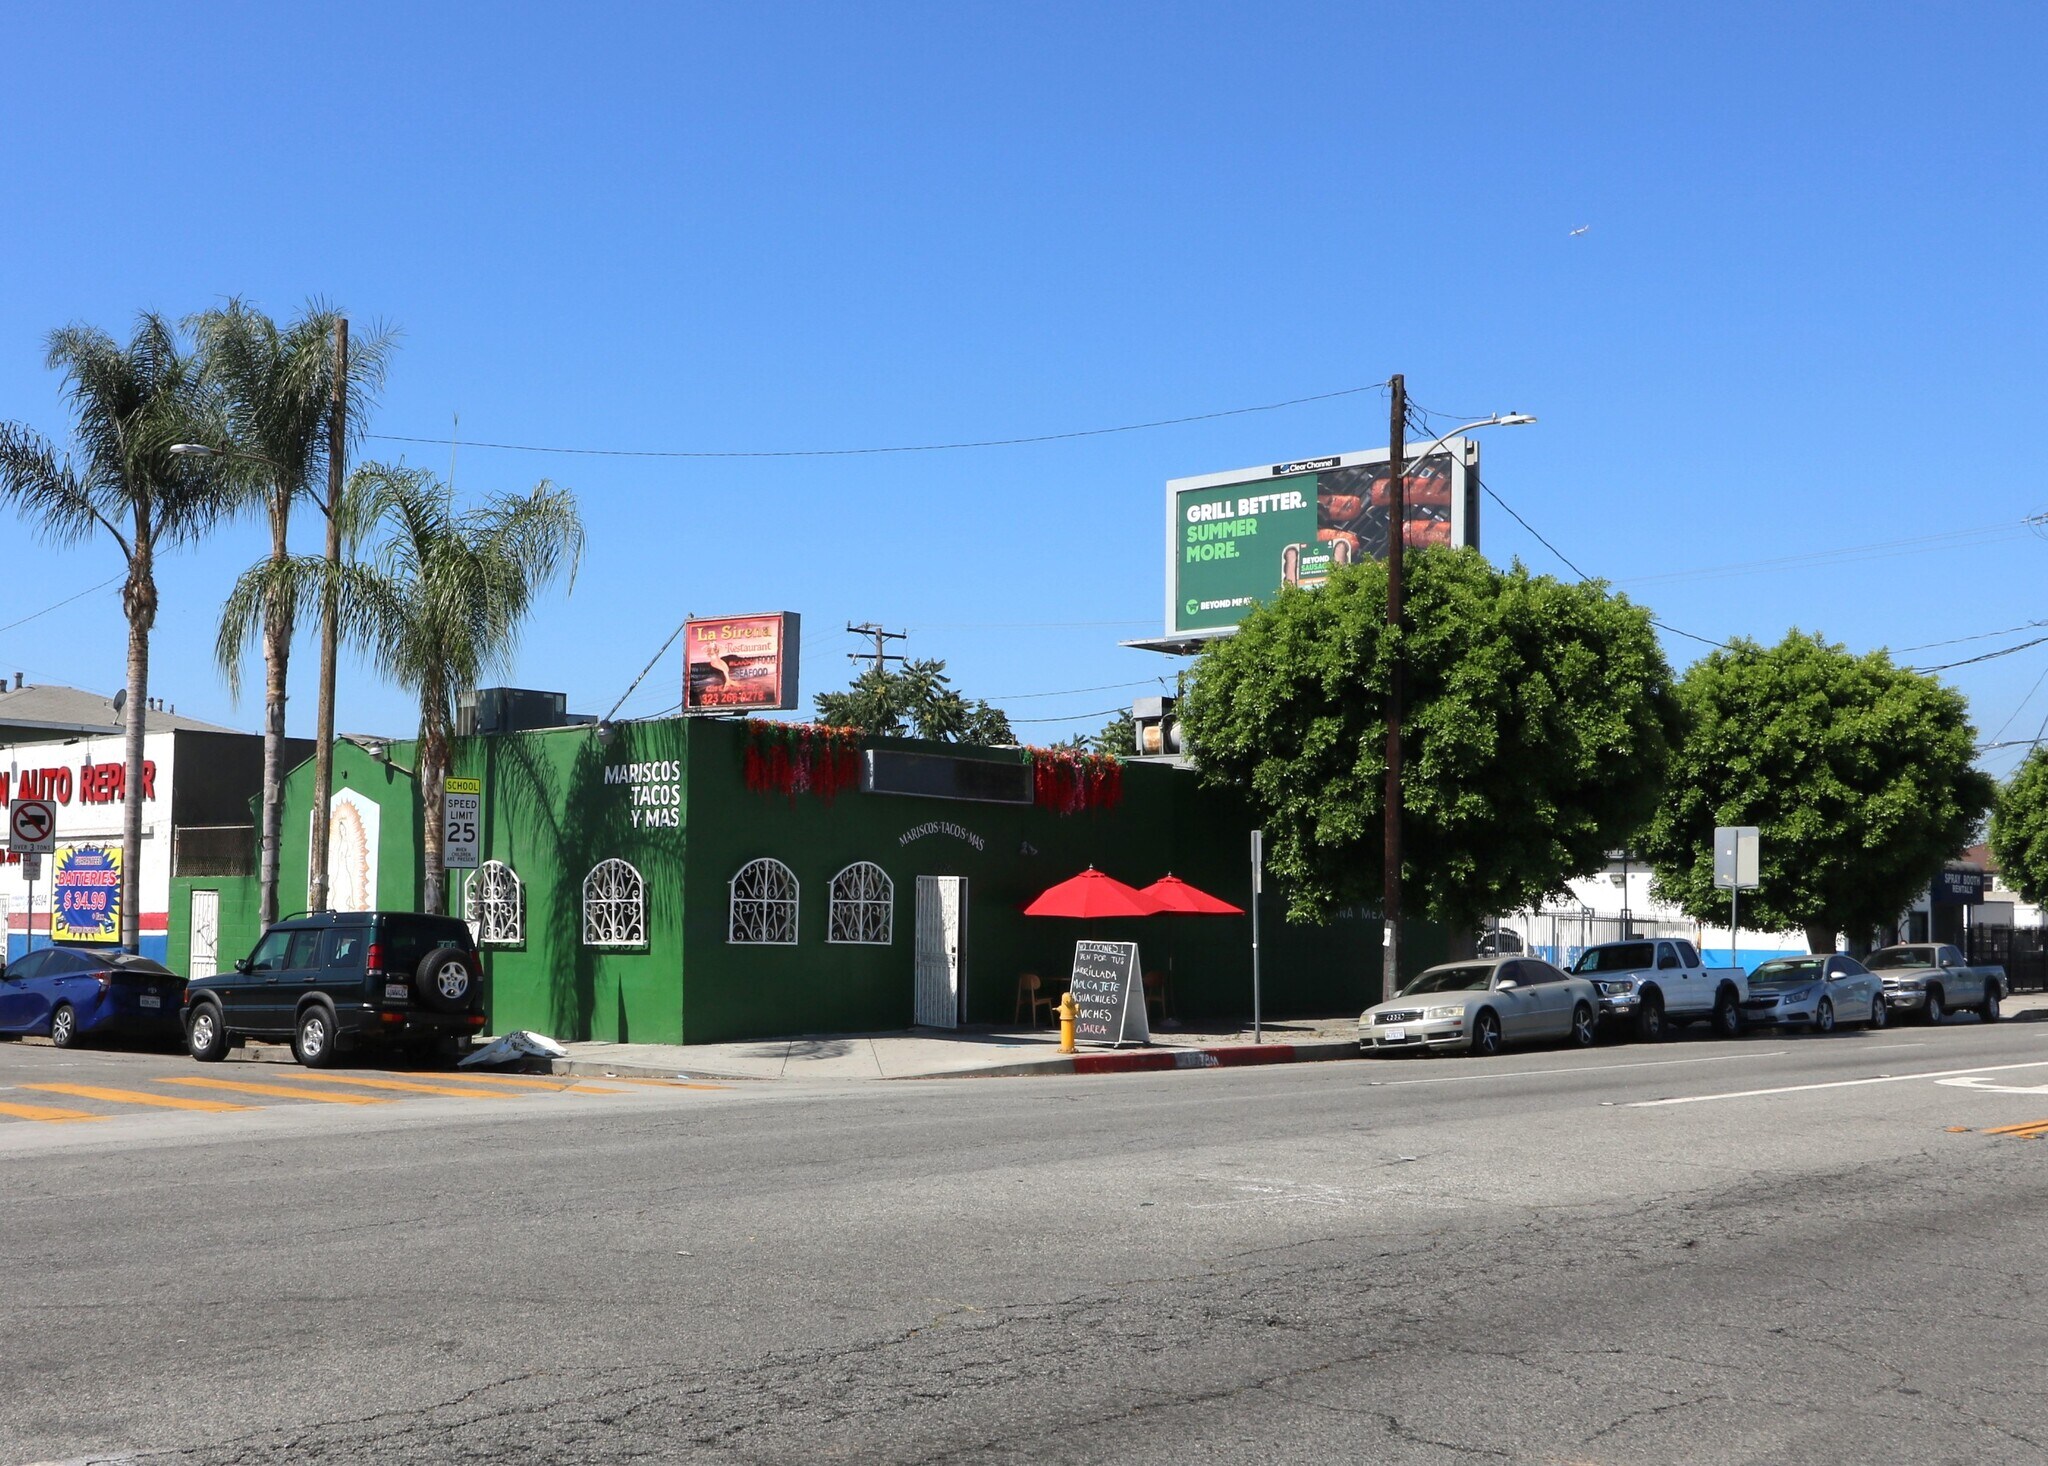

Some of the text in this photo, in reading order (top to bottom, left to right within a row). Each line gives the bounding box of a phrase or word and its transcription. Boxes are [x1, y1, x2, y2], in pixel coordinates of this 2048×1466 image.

[1290, 459, 1333, 473] Clear Channel
[1187, 491, 1307, 523] GRILL BETTER.
[1187, 518, 1257, 543] SUMMER
[1186, 541, 1240, 563] MORE.
[1302, 554, 1330, 565] BEYOND
[1200, 599, 1230, 610] BEYOND
[697, 624, 772, 641] La Sirena
[726, 642, 772, 653] Restaurant
[758, 655, 776, 665] FOOD
[734, 667, 768, 678] SEAFOOD
[702, 693, 719, 704] 323
[604, 760, 681, 785] MARISCOS
[18, 766, 72, 804] AUTO
[80, 760, 156, 805] REPAR
[447, 781, 479, 791] SCHOOL
[448, 800, 477, 809] SPEED
[450, 811, 473, 820] LIMIT
[645, 807, 680, 828] MAS
[447, 822, 475, 843] 25
[30, 843, 35, 852] 3
[58, 870, 117, 887] BATTERIES
[1944, 873, 1981, 886] SPRAY BOOTH
[1952, 884, 1974, 894] RENTALS
[63, 890, 72, 911] $
[73, 891, 107, 910] 34.99
[1093, 954, 1107, 962] POR
[1075, 1009, 1112, 1022] VICHES
